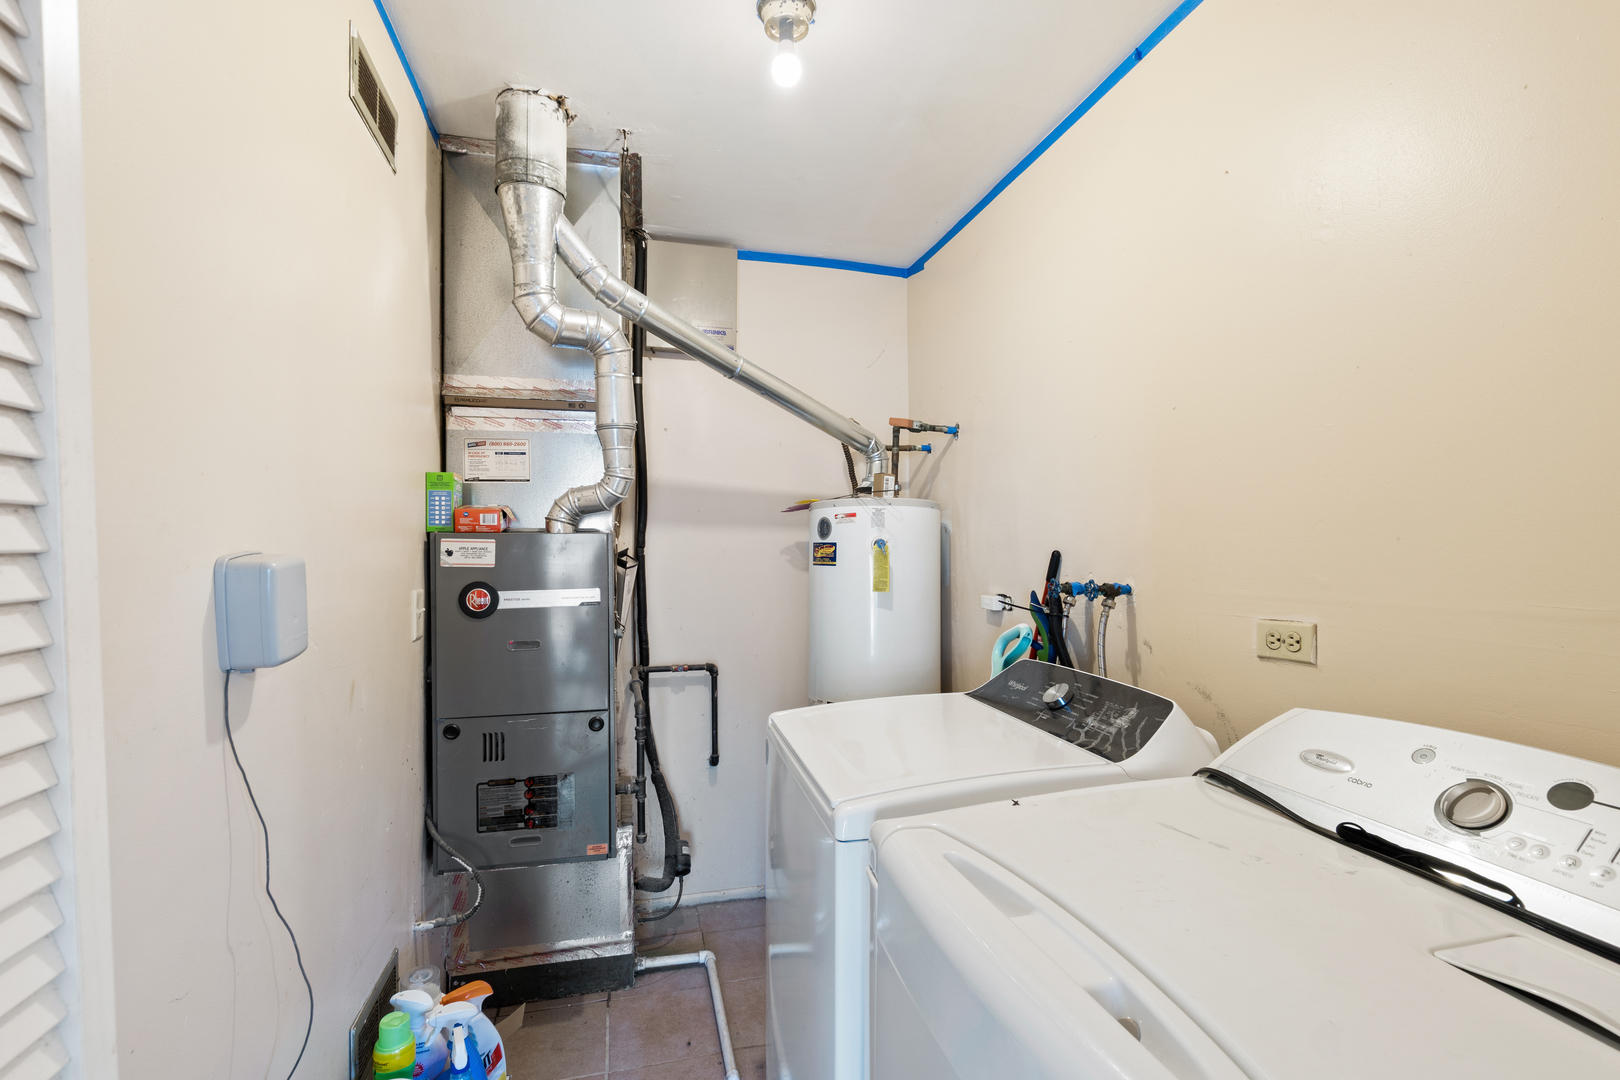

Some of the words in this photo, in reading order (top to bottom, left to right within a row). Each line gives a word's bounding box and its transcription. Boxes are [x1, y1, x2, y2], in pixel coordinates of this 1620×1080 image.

[469, 591, 489, 607] Rheem
[1007, 680, 1029, 691] Whirlpool
[1315, 754, 1338, 765] Whirlpool
[1483, 773, 1504, 781] NORMAL
[1347, 777, 1373, 789] cabrio
[1505, 781, 1524, 790] CASUAL
[1516, 791, 1540, 801] DELICATE
[1590, 837, 1608, 845] Normal
[1581, 849, 1595, 858] Damp
[1518, 856, 1536, 865] ADJUST
[1552, 868, 1574, 879] DRYNESS
[1589, 881, 1604, 889] TEMP
